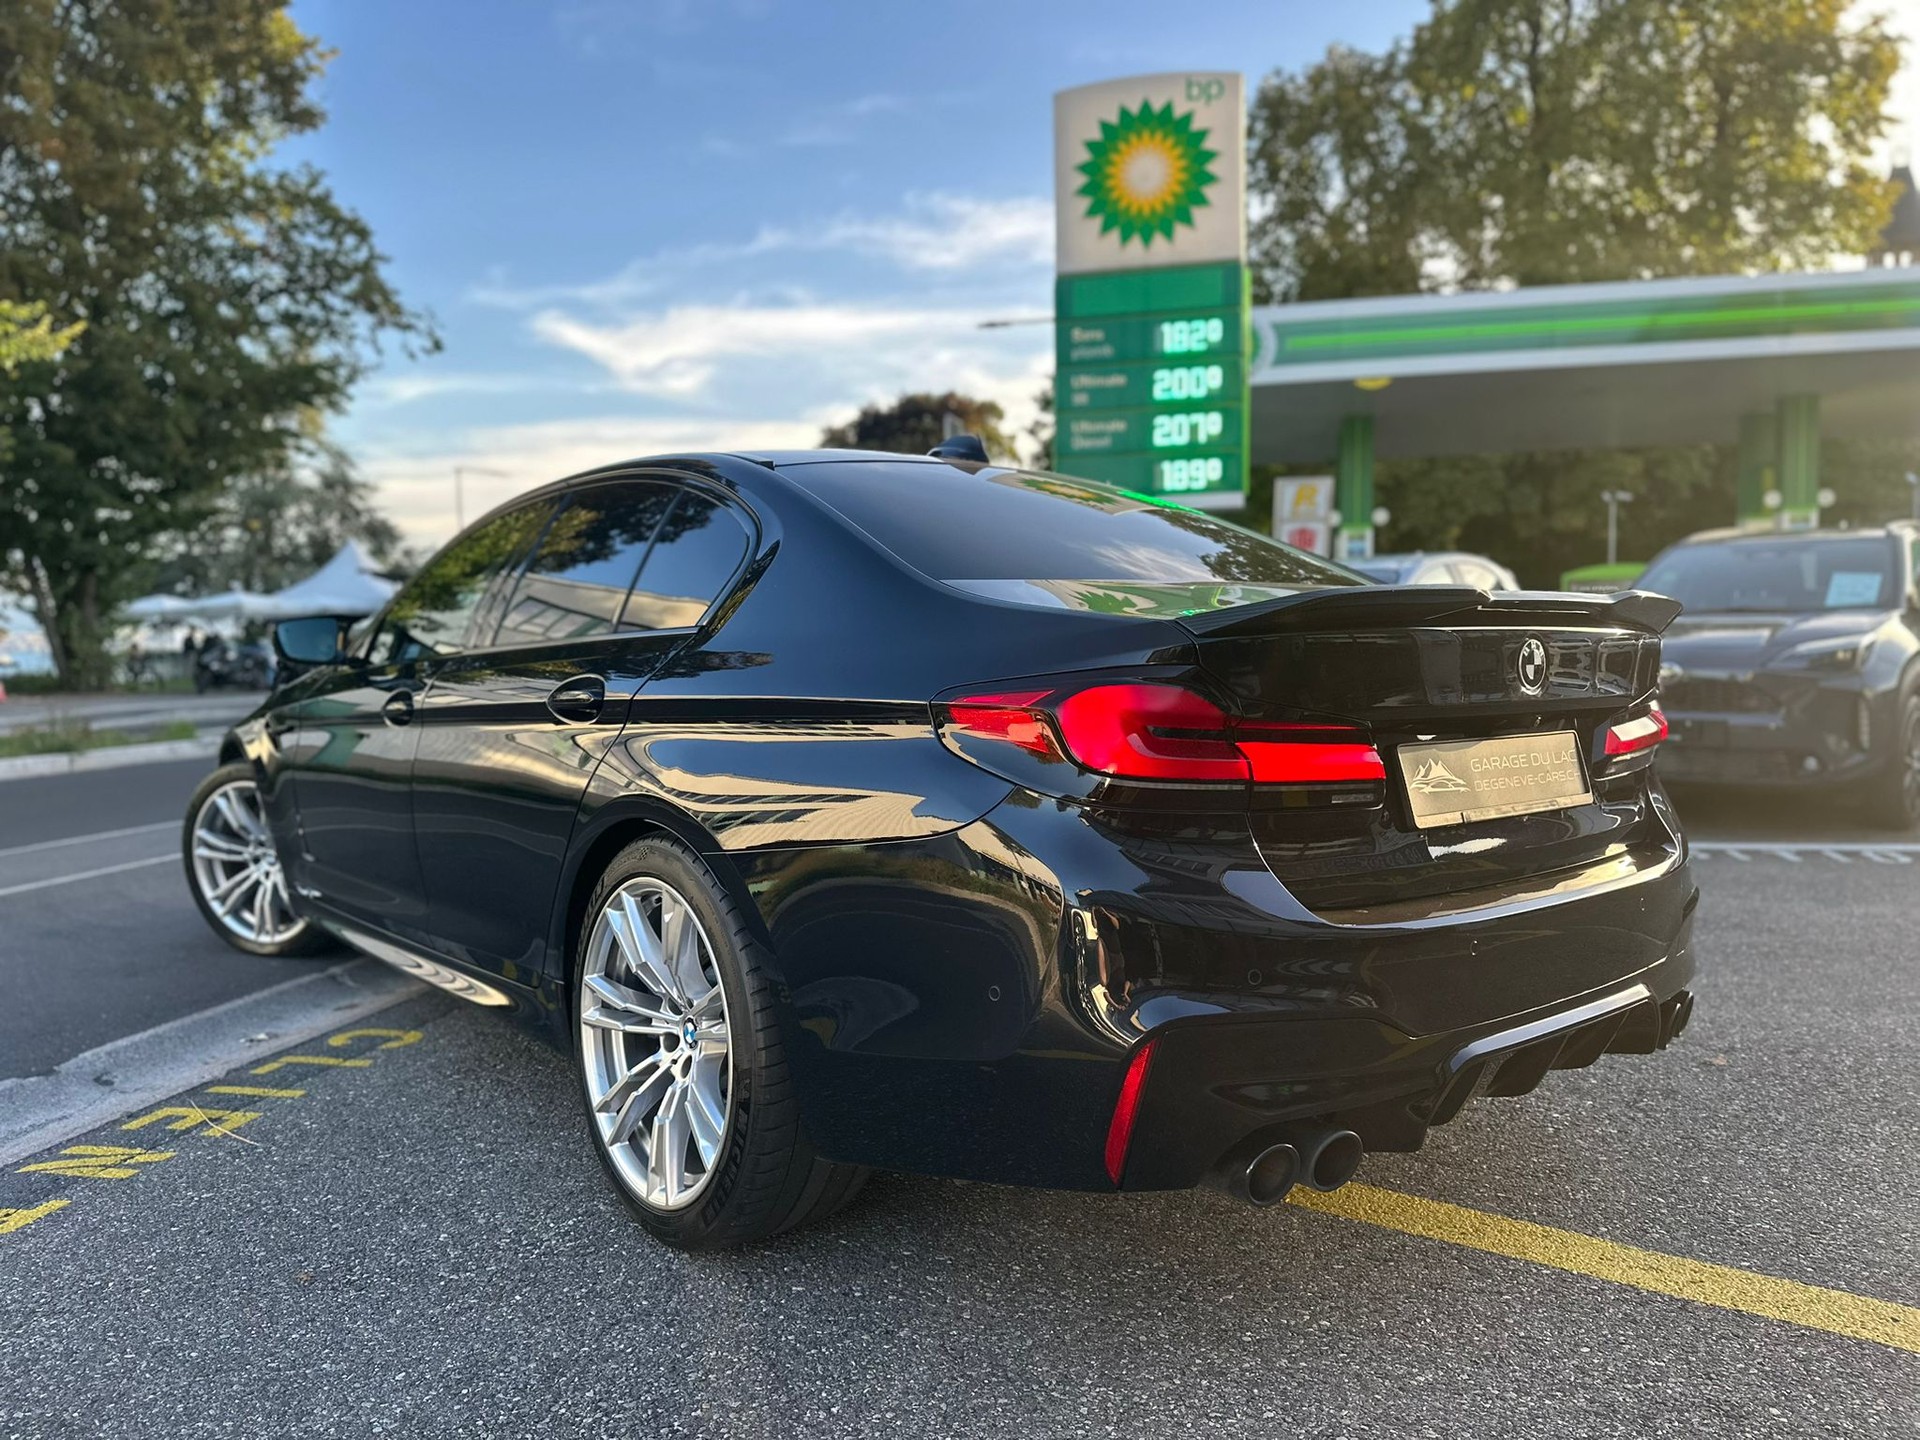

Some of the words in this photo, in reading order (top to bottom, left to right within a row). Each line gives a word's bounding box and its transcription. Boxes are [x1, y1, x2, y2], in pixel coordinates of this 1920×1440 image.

[1185, 77, 1225, 105] bp
[1470, 753, 1529, 772] GARAGE
[1530, 751, 1551, 766] DU
[1552, 749, 1578, 764] LAC
